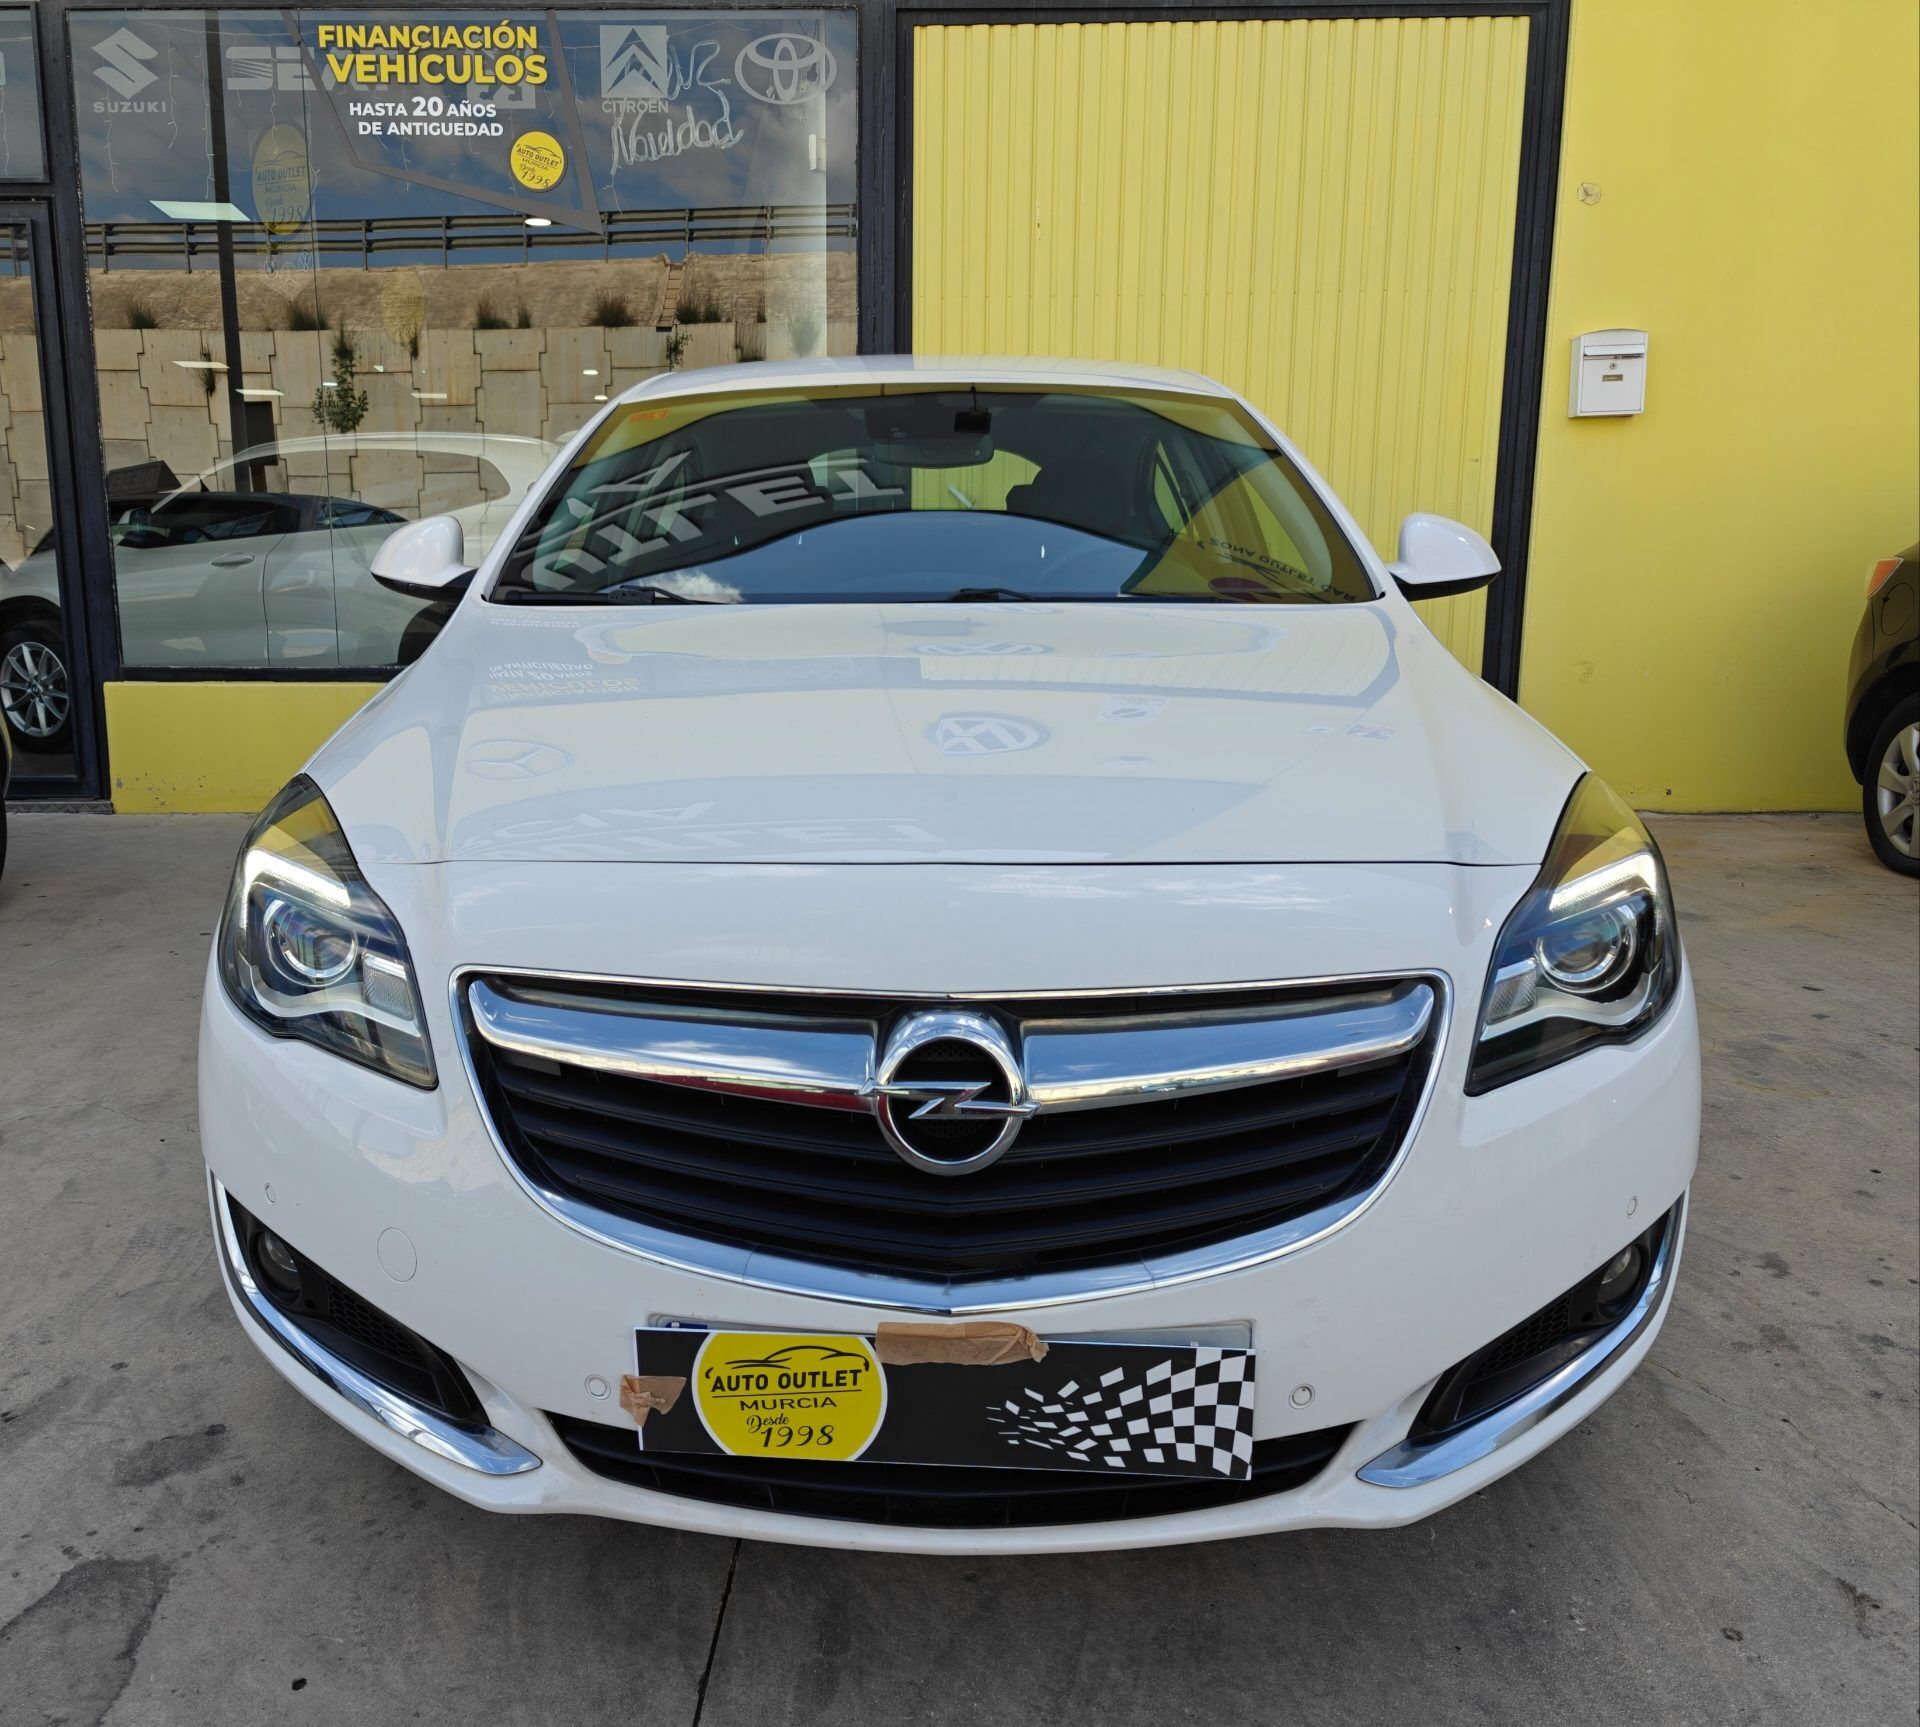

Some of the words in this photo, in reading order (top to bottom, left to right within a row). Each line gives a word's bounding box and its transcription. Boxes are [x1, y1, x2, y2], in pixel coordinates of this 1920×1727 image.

[318, 19, 538, 50] FINANCIACIÓN
[326, 46, 549, 85] VEHÍCULOS
[92, 101, 167, 114] SUZUKI
[349, 102, 408, 117] HASTA
[411, 96, 444, 117] 20
[446, 100, 497, 118] AÑOS
[358, 121, 383, 135] DE
[386, 121, 504, 137] ANTIGUEDAD
[516, 147, 534, 158] AUTO
[534, 154, 559, 168] OUTLET
[256, 168, 276, 181] AUTO
[278, 165, 307, 180] OUTLET
[521, 171, 551, 188] 1998
[265, 183, 297, 194] MURCIA
[710, 1373, 769, 1393] AUTO
[777, 1369, 862, 1390] OUTLET
[739, 1396, 838, 1411] MURCIA
[746, 1413, 790, 1434] Desde
[760, 1425, 835, 1448] 1998
